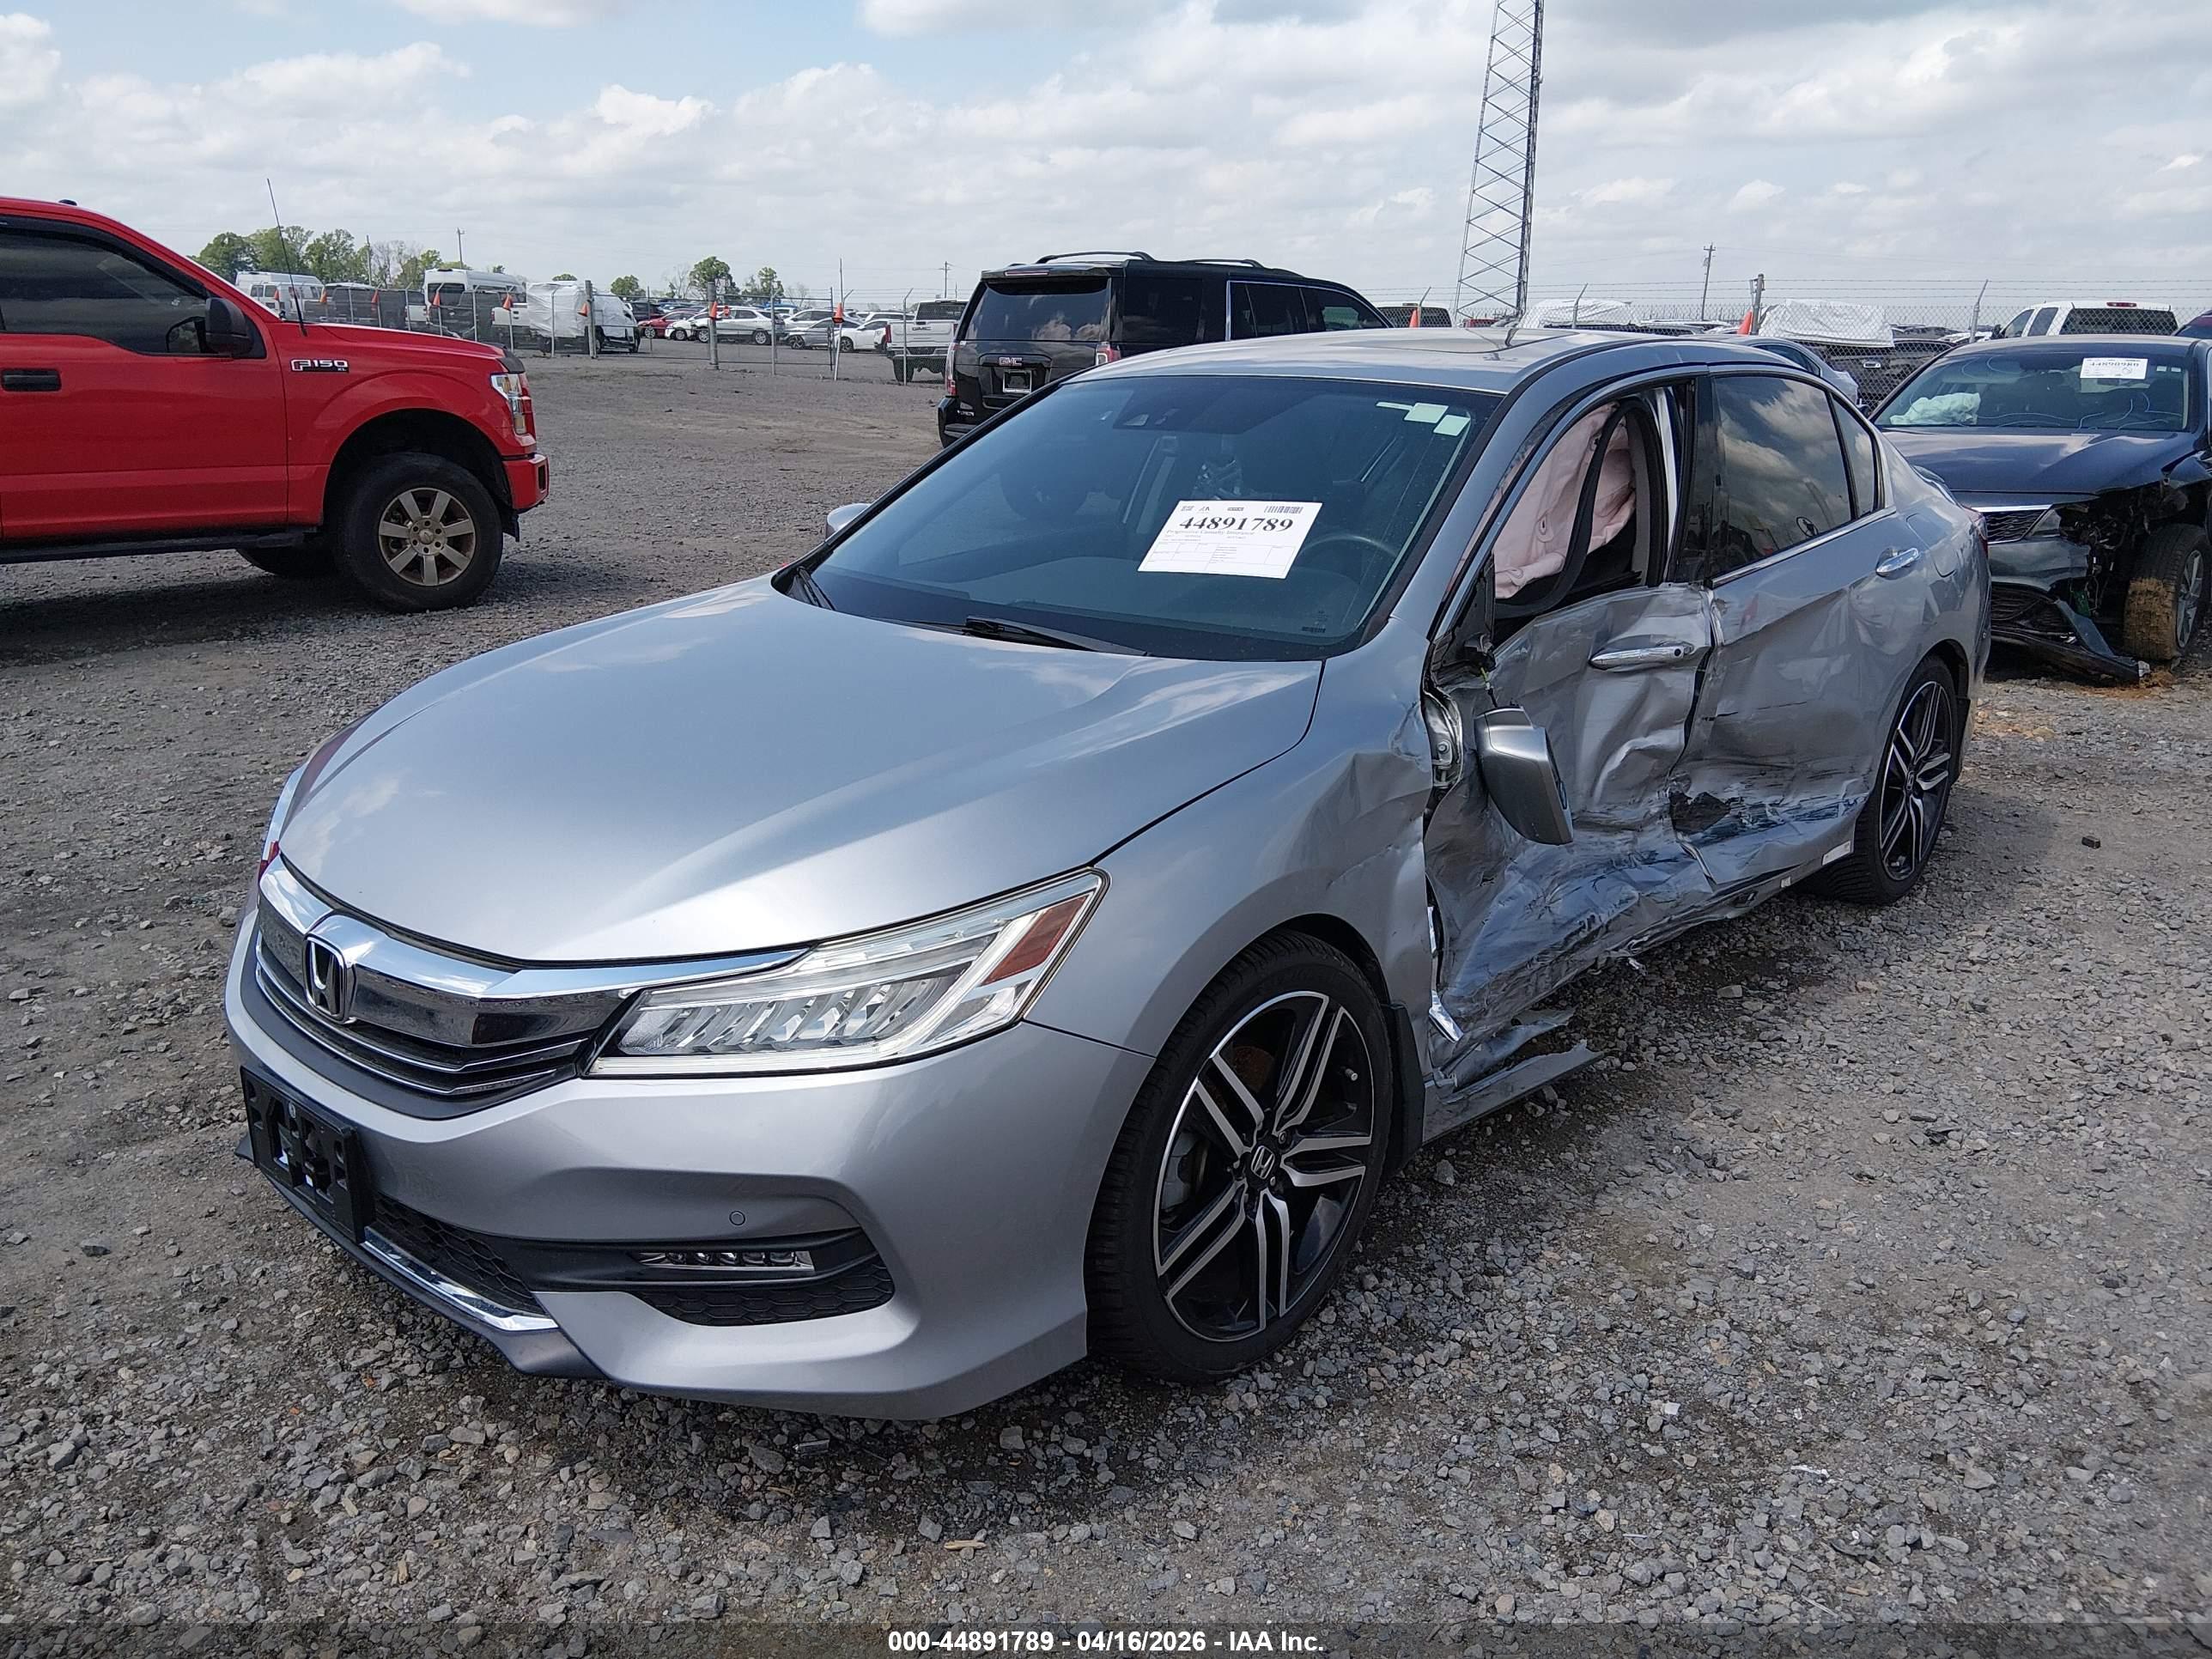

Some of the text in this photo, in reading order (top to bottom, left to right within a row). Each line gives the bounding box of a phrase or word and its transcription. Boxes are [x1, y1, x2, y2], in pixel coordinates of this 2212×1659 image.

[291, 359, 348, 371] F150
[999, 356, 1023, 367] GMC
[1179, 516, 1293, 532] 44891789
